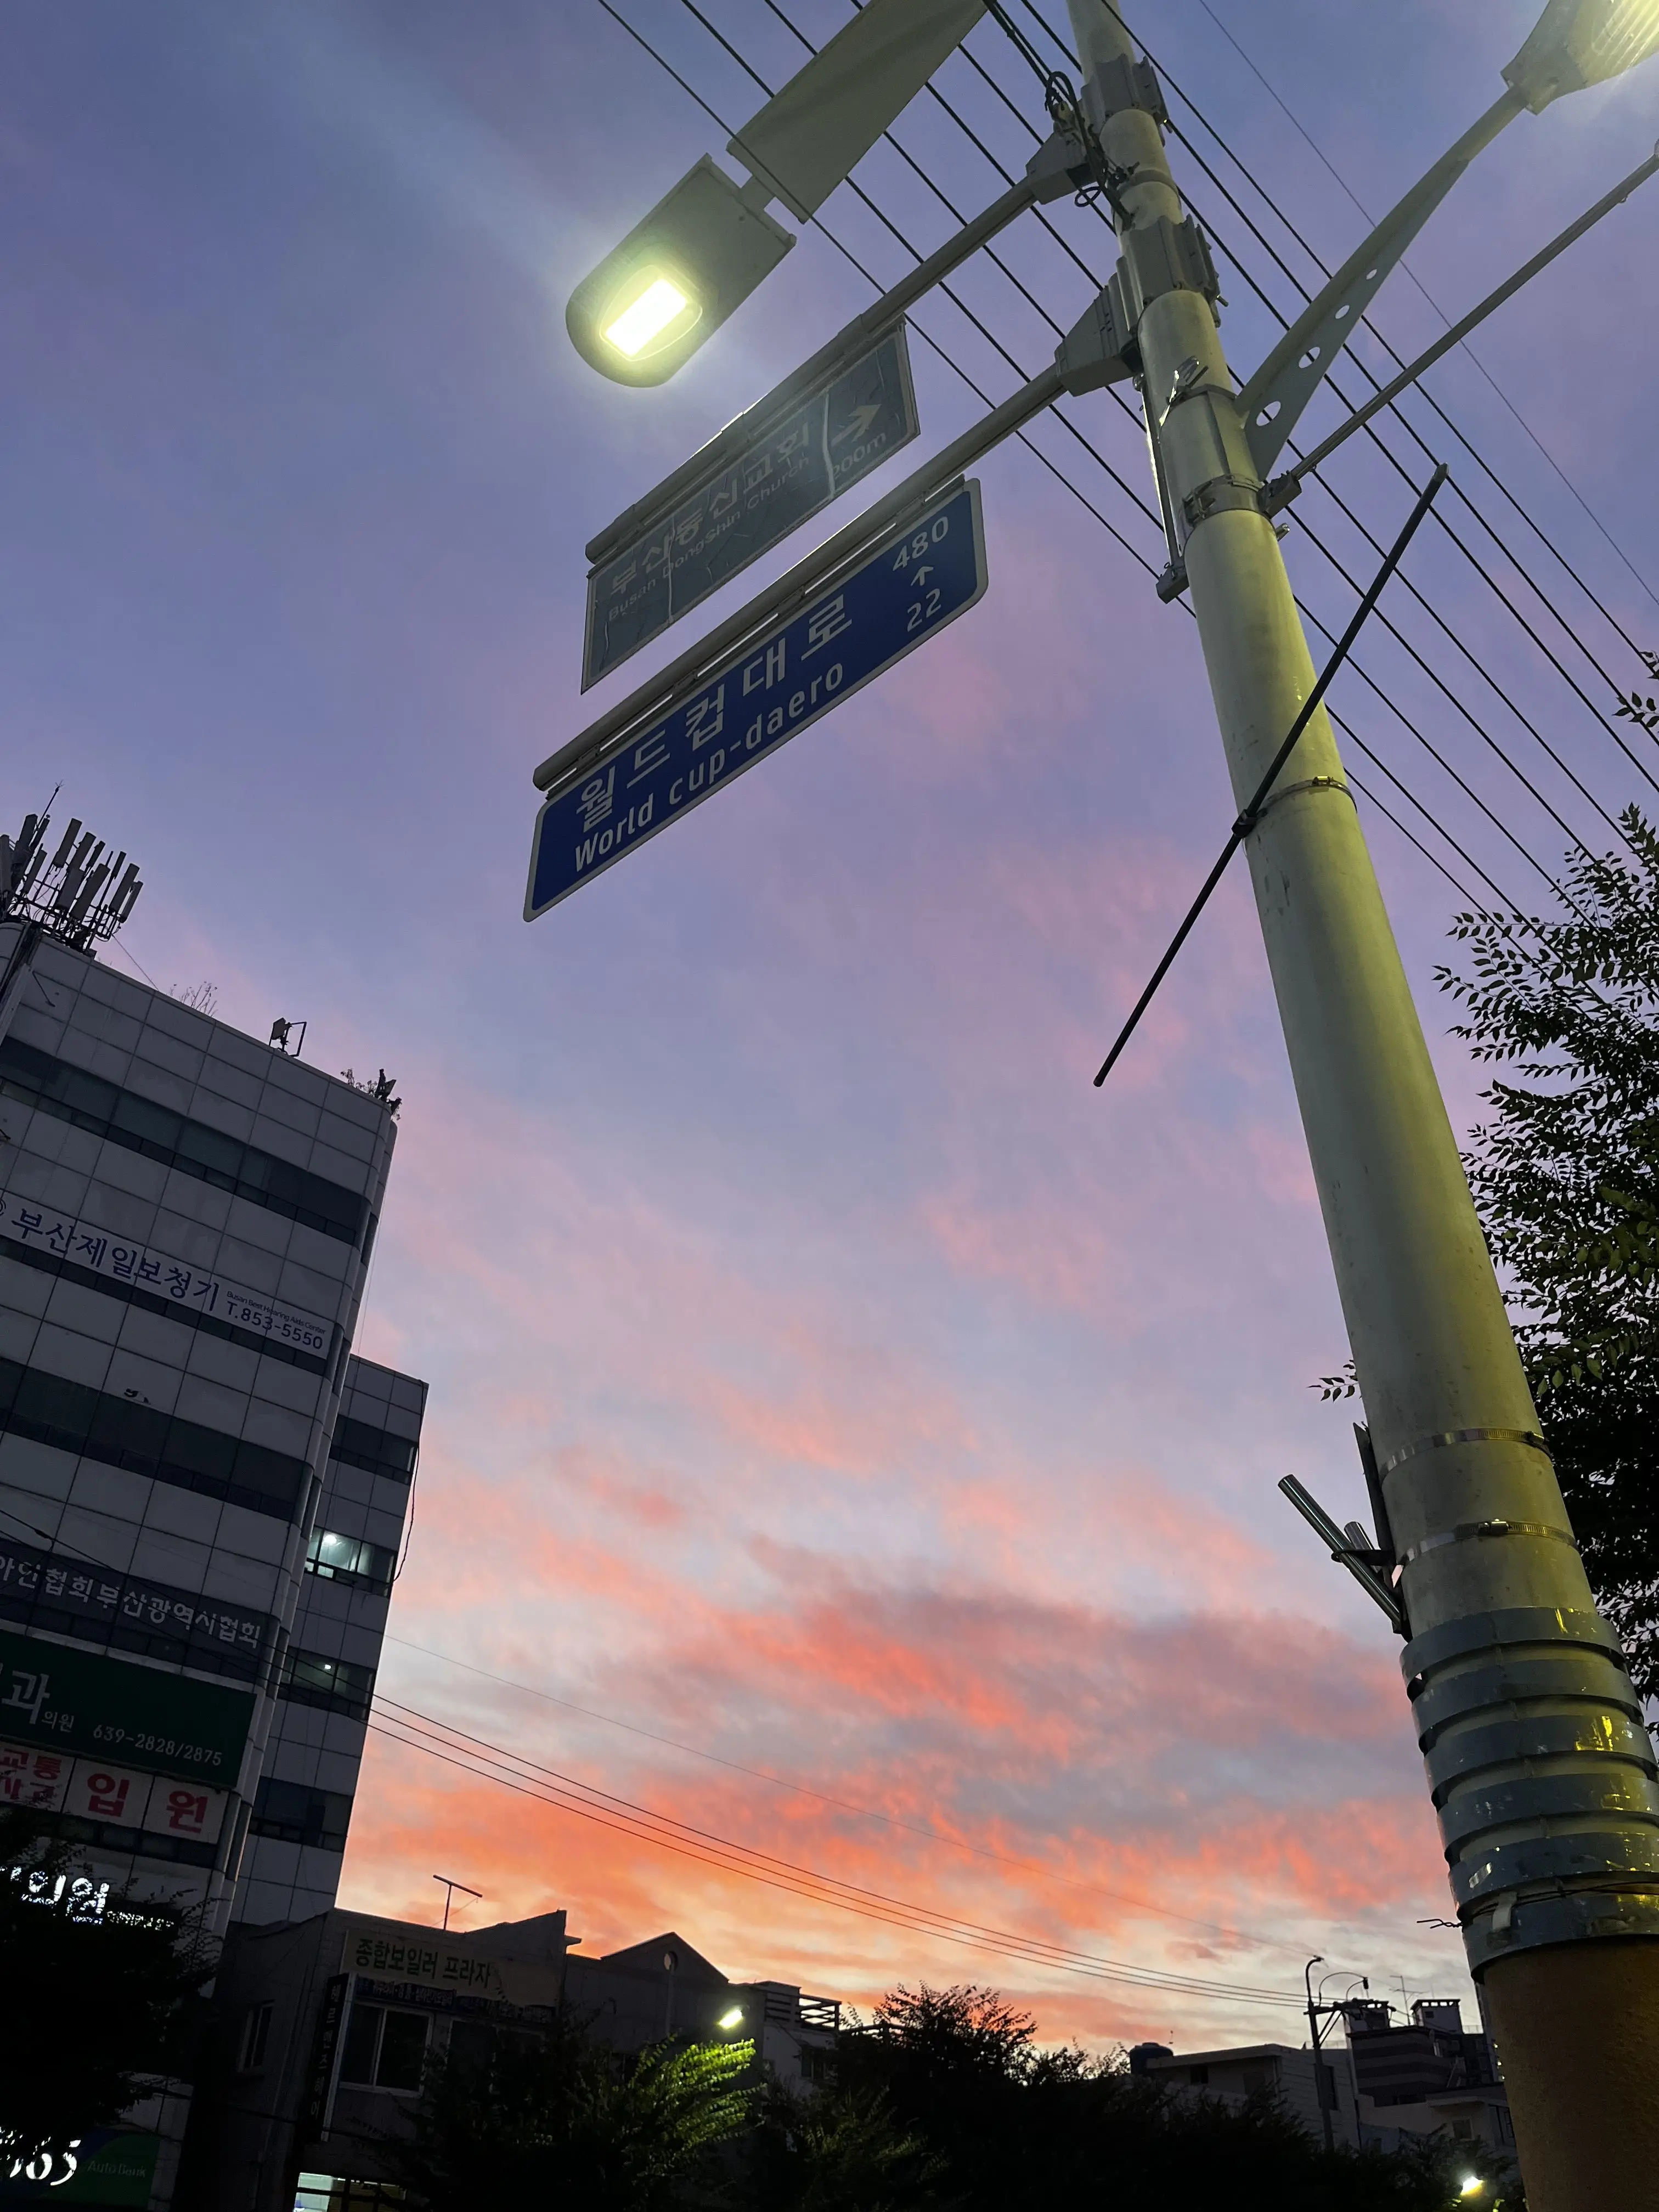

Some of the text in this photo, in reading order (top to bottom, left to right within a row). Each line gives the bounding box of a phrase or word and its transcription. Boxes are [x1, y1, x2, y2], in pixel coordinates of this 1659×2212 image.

[833, 432, 887, 480] 200m
[611, 422, 809, 595] 부산동신교회
[608, 579, 656, 622] Busan
[747, 455, 810, 509] Church
[893, 516, 949, 572] 480
[907, 589, 941, 632] 22
[577, 594, 852, 833] 월드컵대로
[575, 663, 843, 872] World cup-daero
[11, 1208, 219, 1311] 부산제일보청기
[227, 1291, 247, 1304] Busan
[249, 1300, 263, 1310] Best
[304, 1322, 326, 1334] Center
[227, 1301, 323, 1350] T.853-5550
[41, 1710, 76, 1733] 의원
[92, 1724, 223, 1767] 639-2828/2875
[356, 1938, 492, 1988] 종합보일러 프라자
